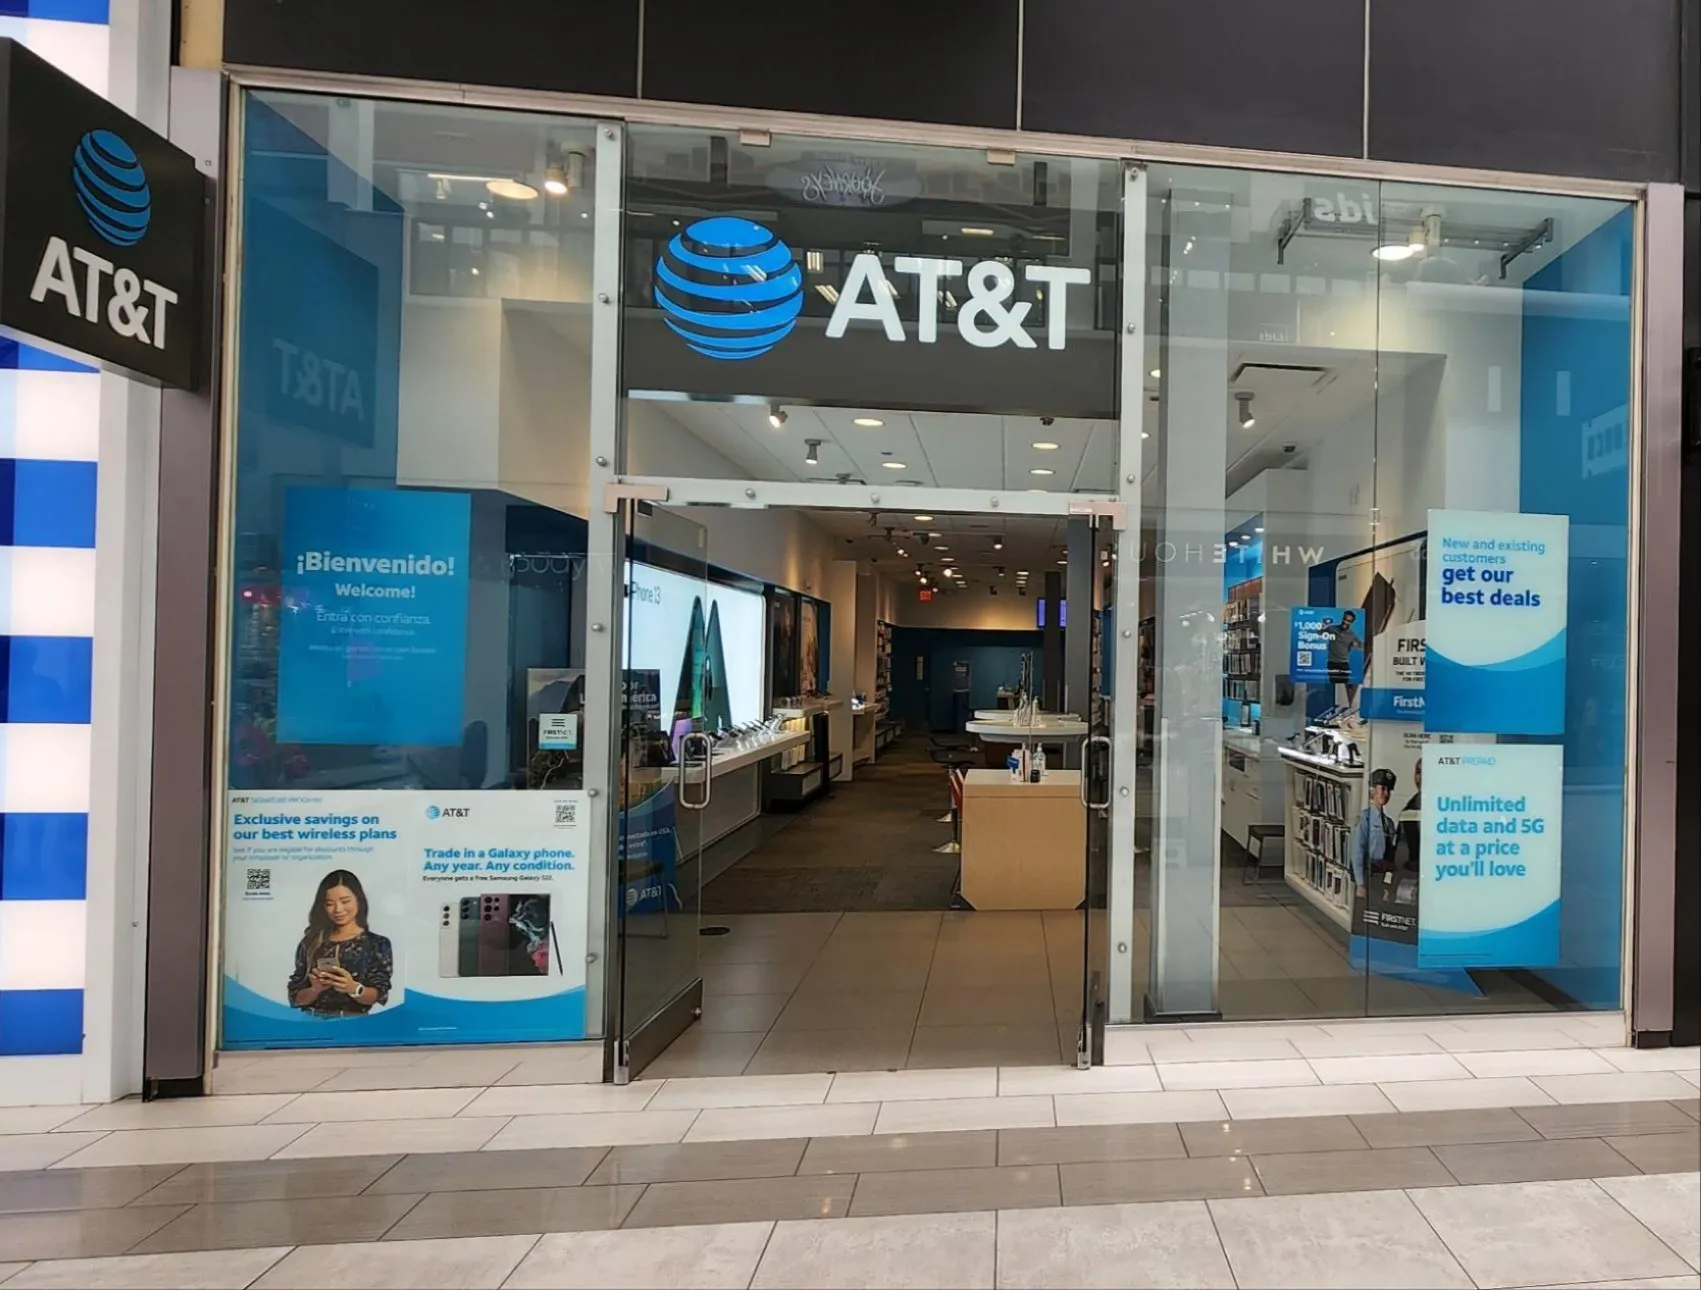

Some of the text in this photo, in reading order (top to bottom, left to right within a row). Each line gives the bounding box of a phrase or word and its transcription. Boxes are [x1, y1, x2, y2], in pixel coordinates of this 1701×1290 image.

[30, 236, 178, 349] AT&T
[825, 253, 1091, 350] AT&T
[1442, 538, 1546, 555] New and existing
[297, 551, 455, 576] ¡Bienvenido!
[1442, 552, 1507, 564] customers
[1442, 566, 1514, 585] get our
[335, 583, 416, 598] Welcome!
[1441, 587, 1541, 607] best deals
[350, 613, 372, 623] con
[1298, 631, 1336, 642] Sign-On
[1297, 641, 1327, 650] Bonus
[1438, 757, 1461, 765] AT&T
[1437, 796, 1526, 812] Unlimited
[442, 808, 470, 817] AT&T
[234, 813, 379, 828] Exclusive savings on
[1436, 818, 1544, 834] data and 5G
[233, 828, 397, 842] our best wireless plans
[424, 848, 460, 858] Trade
[464, 848, 475, 858] in
[488, 848, 530, 860] Galaxy
[533, 849, 575, 860] phone.
[1436, 838, 1520, 859] at a price
[424, 861, 575, 873] Any year. Any condition.
[1435, 861, 1526, 881] you'll love
